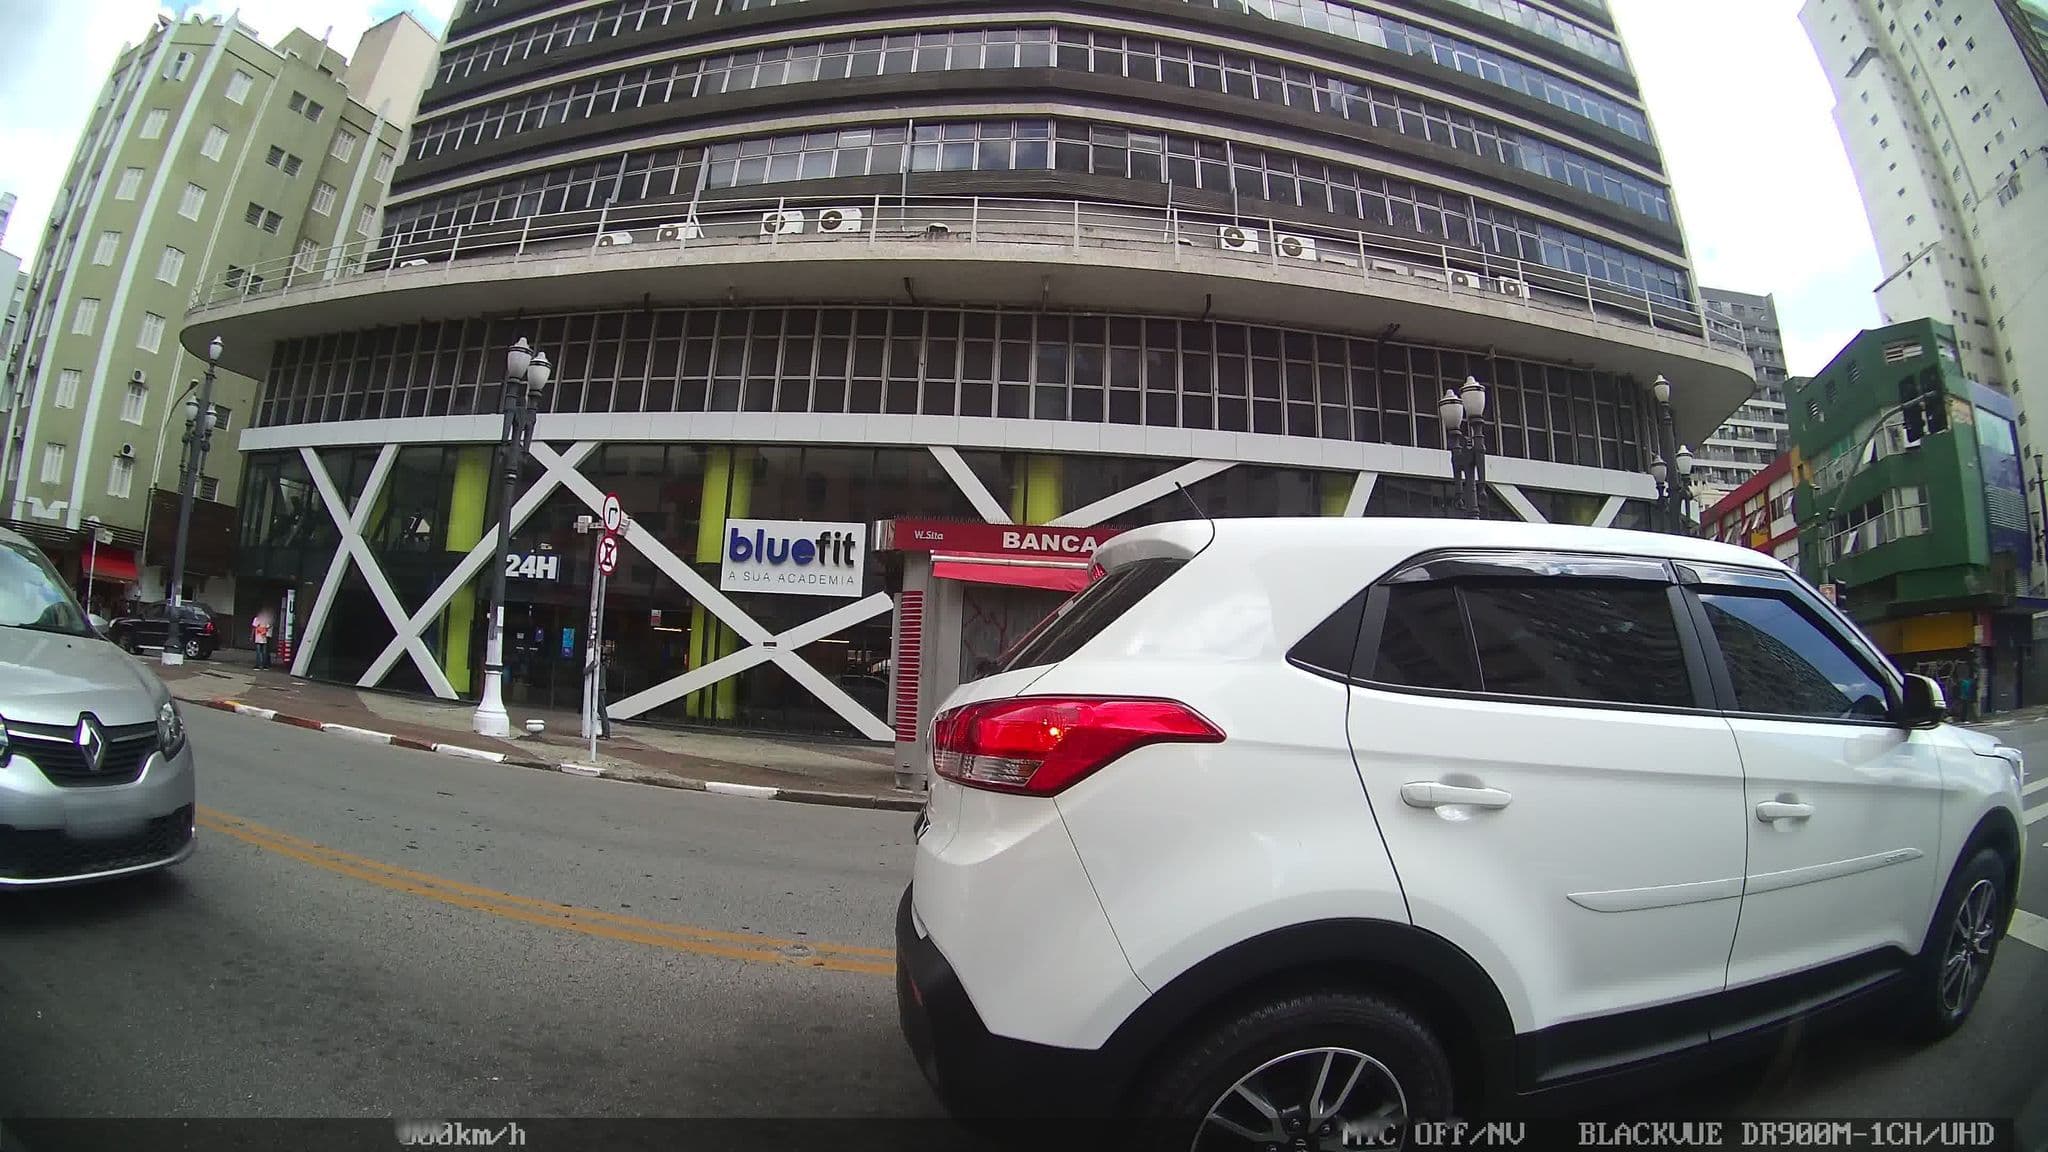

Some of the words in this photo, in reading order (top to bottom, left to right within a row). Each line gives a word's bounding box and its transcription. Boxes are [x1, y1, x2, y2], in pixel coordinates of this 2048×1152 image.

[728, 527, 856, 569] bluefit
[1003, 531, 1098, 553] BANCA
[505, 554, 558, 580] 24H
[728, 571, 736, 581] A
[743, 571, 771, 582] SUA
[778, 573, 855, 586] ACADEMIA
